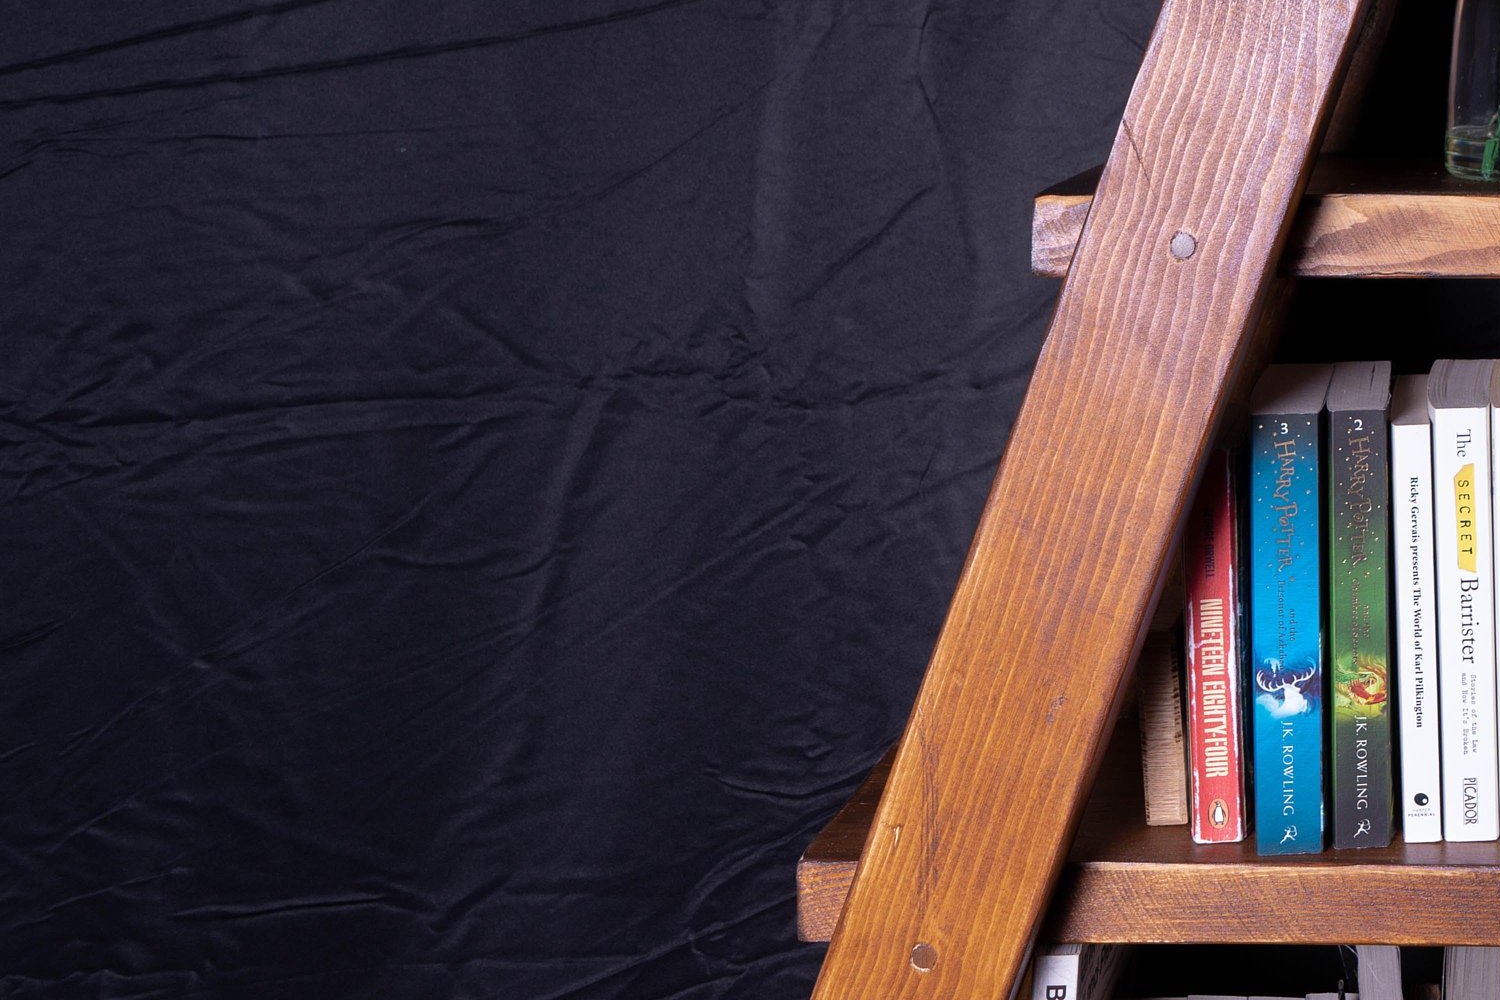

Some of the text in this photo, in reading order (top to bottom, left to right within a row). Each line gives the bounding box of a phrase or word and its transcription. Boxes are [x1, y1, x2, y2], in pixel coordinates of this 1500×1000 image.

[1280, 422, 1289, 435] 3
[1353, 418, 1364, 431] 2
[1456, 428, 1472, 458] The
[1273, 439, 1299, 573] HARRY POTTER
[1347, 435, 1373, 567] HARRY POTTER
[1457, 479, 1473, 555] SECRET
[1203, 507, 1216, 578] ORGE ORWELL
[1278, 580, 1287, 620] Prisoner
[1289, 608, 1299, 642] and the
[1408, 477, 1425, 729] Ricky Gervais presents The World of Karl Pilkington
[1460, 577, 1479, 664] Barrister
[1199, 598, 1229, 778] NINETEEN EIGHTY-FOUR
[1281, 720, 1297, 817] J.K. ROWLING
[1354, 714, 1370, 811] J.K. ROWLING
[1463, 777, 1479, 826] PICADOR
